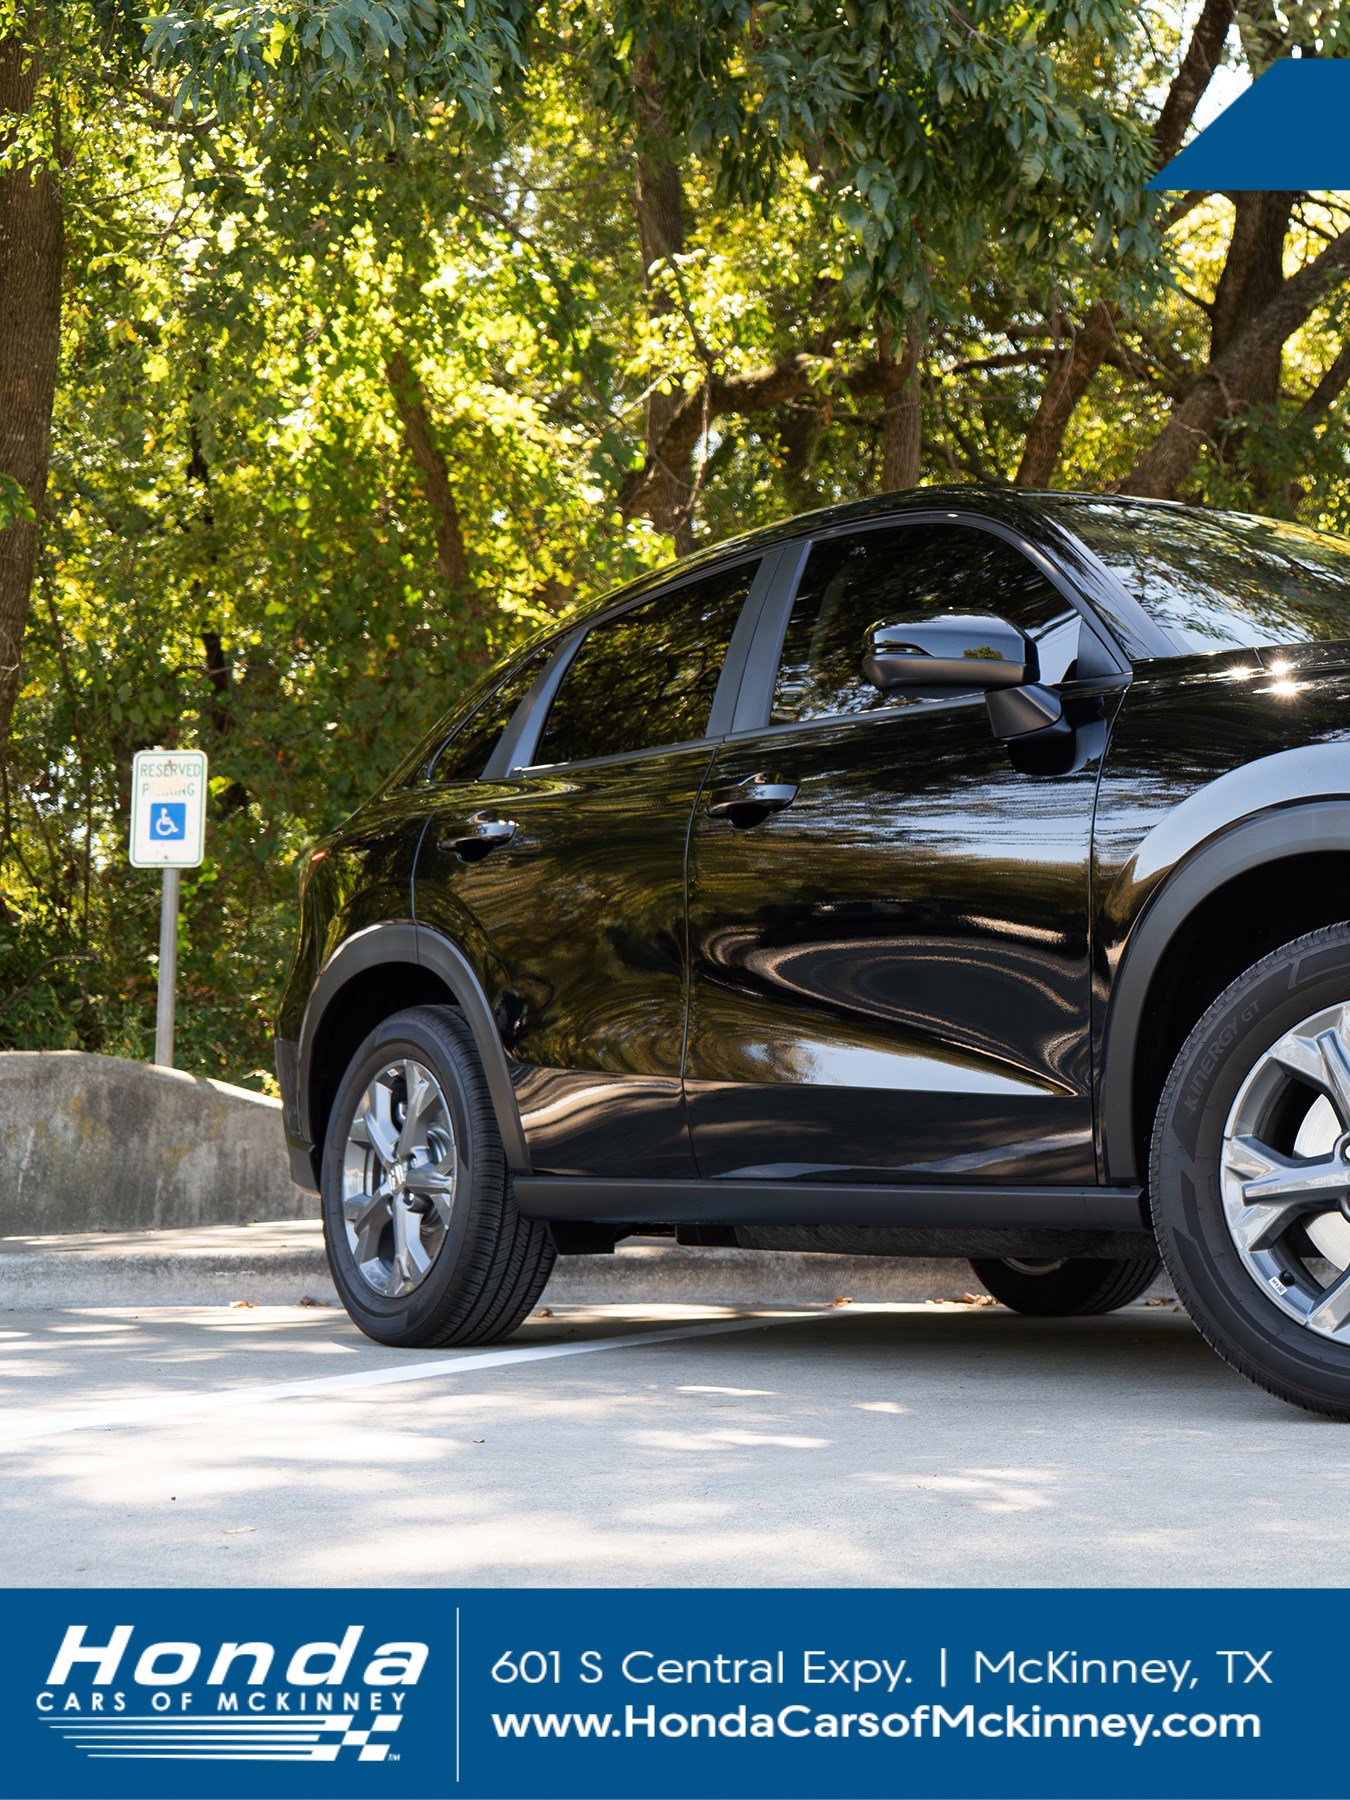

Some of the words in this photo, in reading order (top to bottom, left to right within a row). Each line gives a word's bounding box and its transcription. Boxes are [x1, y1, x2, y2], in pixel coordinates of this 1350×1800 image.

[140, 763, 201, 777] RESERVED
[1183, 1016, 1239, 1113] KINERGY
[1241, 999, 1261, 1022] GT
